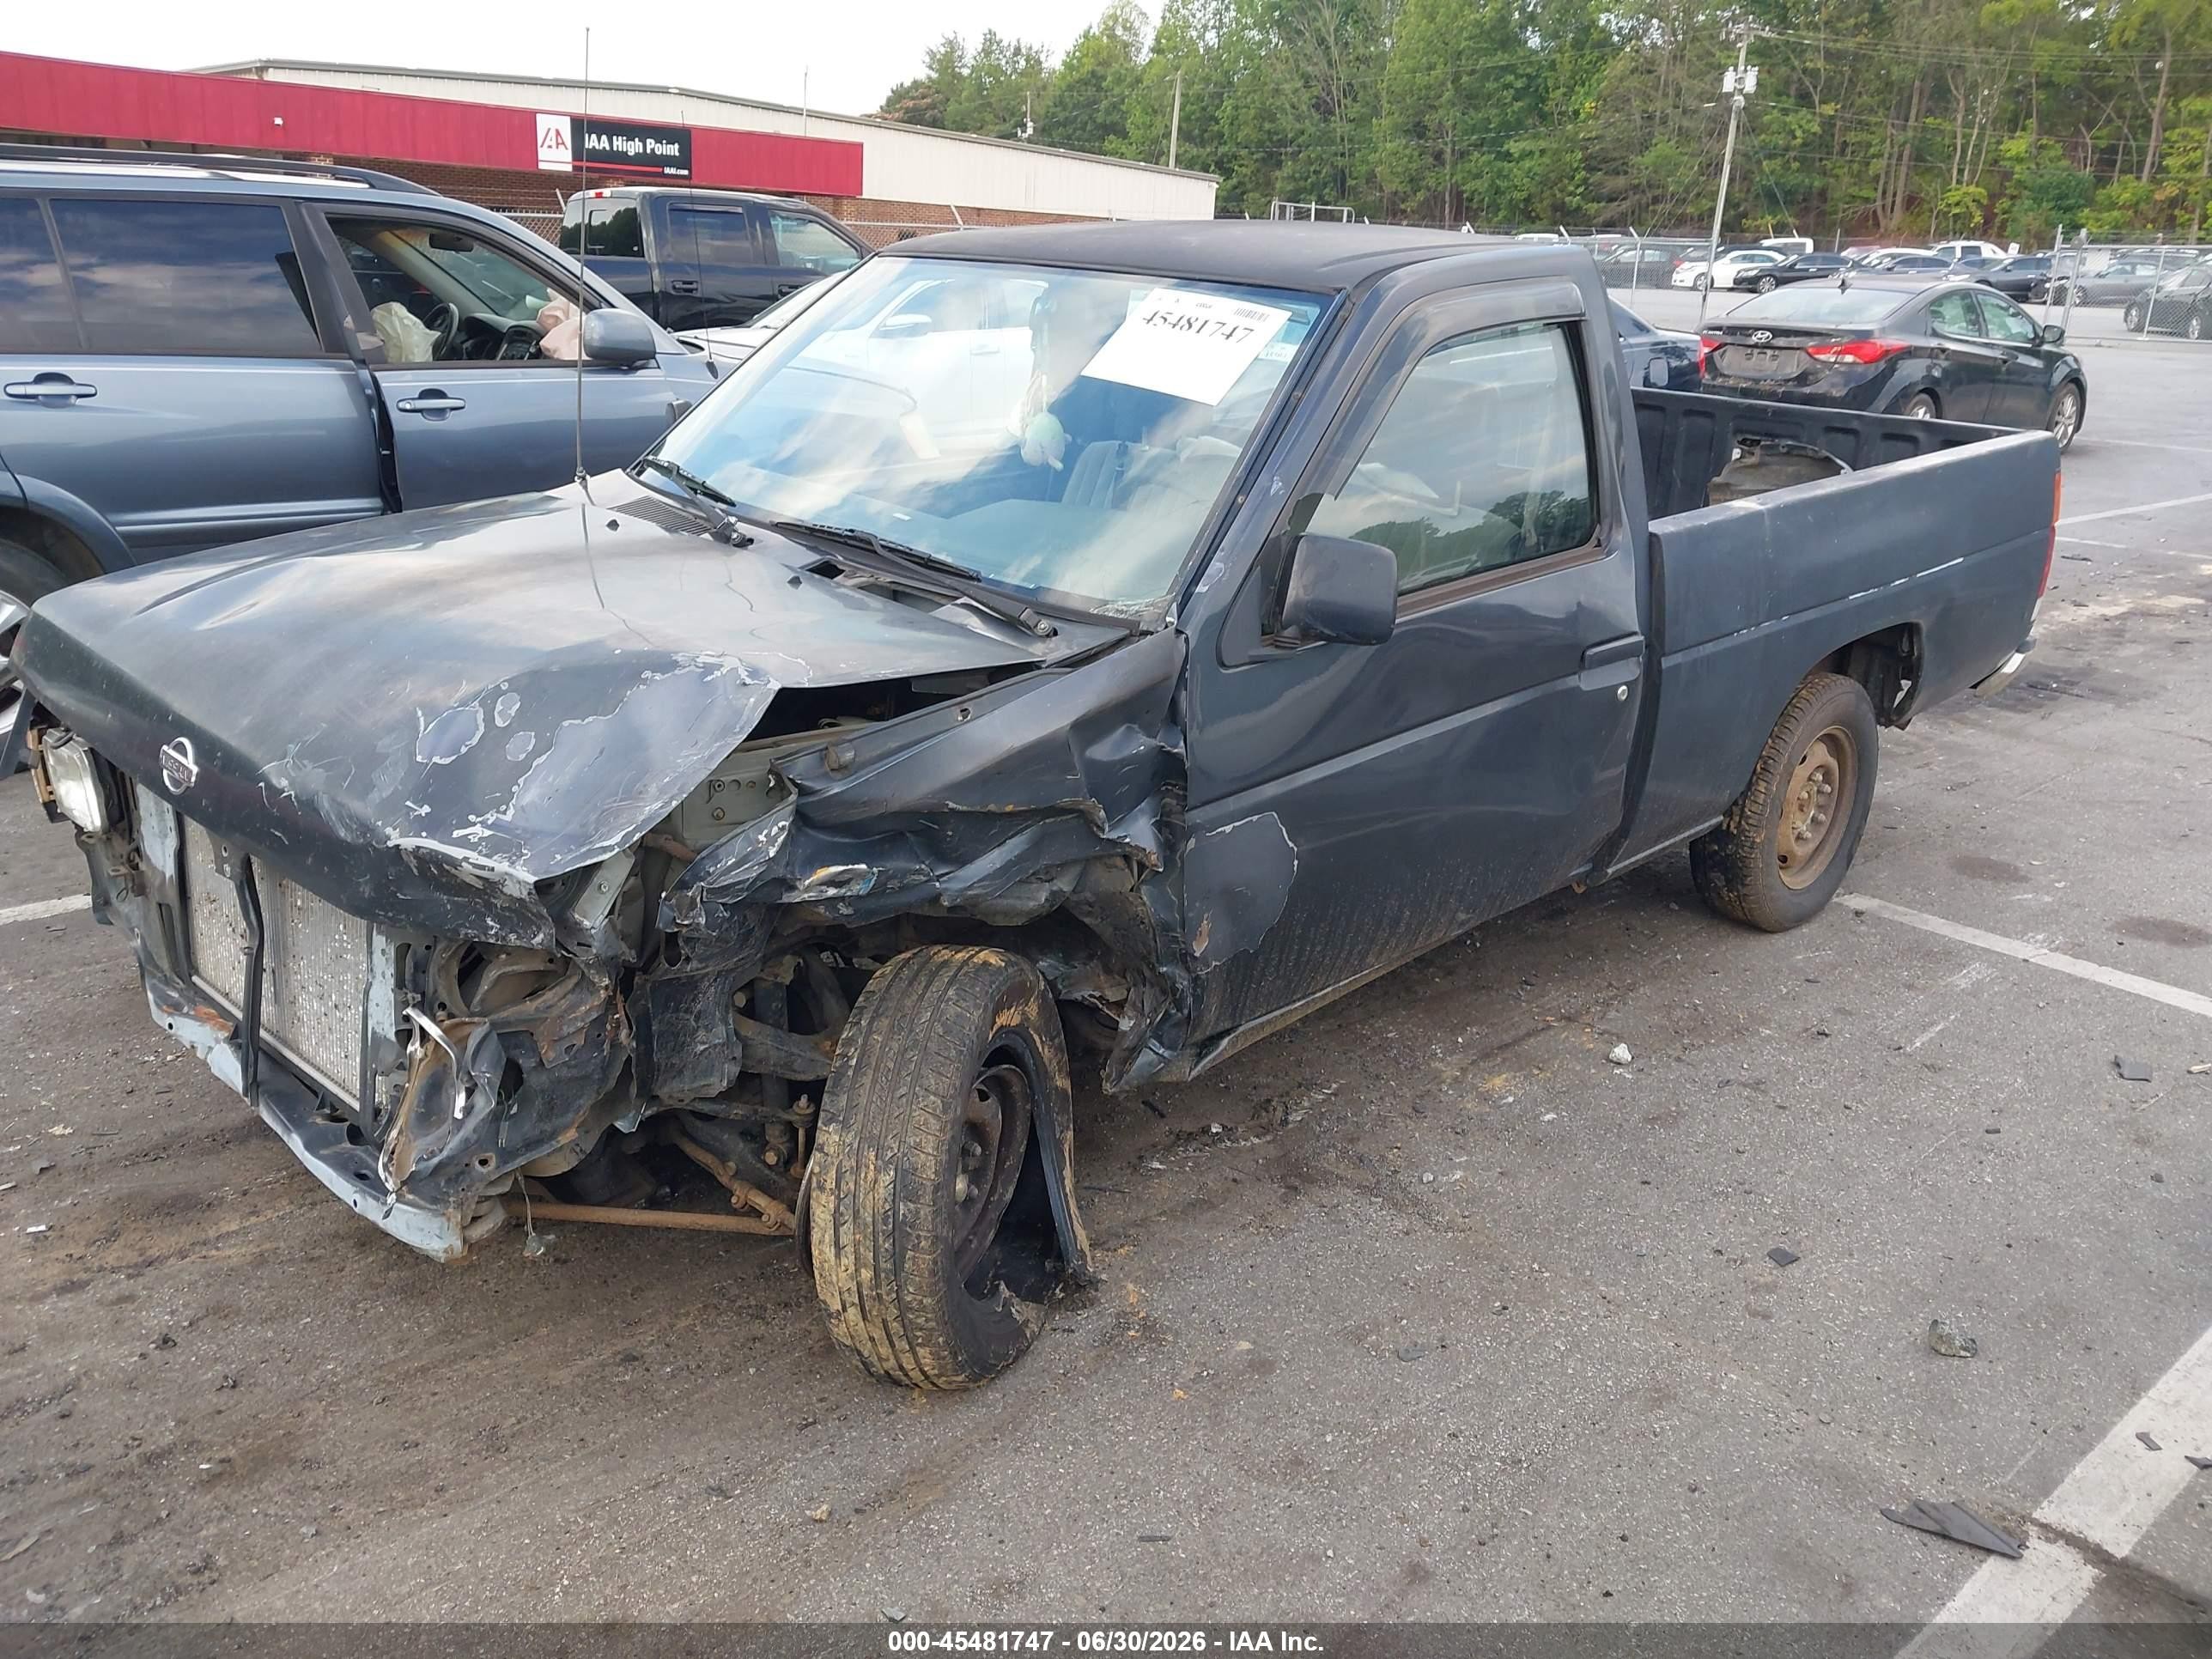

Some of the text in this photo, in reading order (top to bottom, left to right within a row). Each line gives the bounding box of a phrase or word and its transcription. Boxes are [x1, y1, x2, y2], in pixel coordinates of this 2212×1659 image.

[585, 132, 680, 156] IAA High Point
[1142, 309, 1255, 343] 45481747
